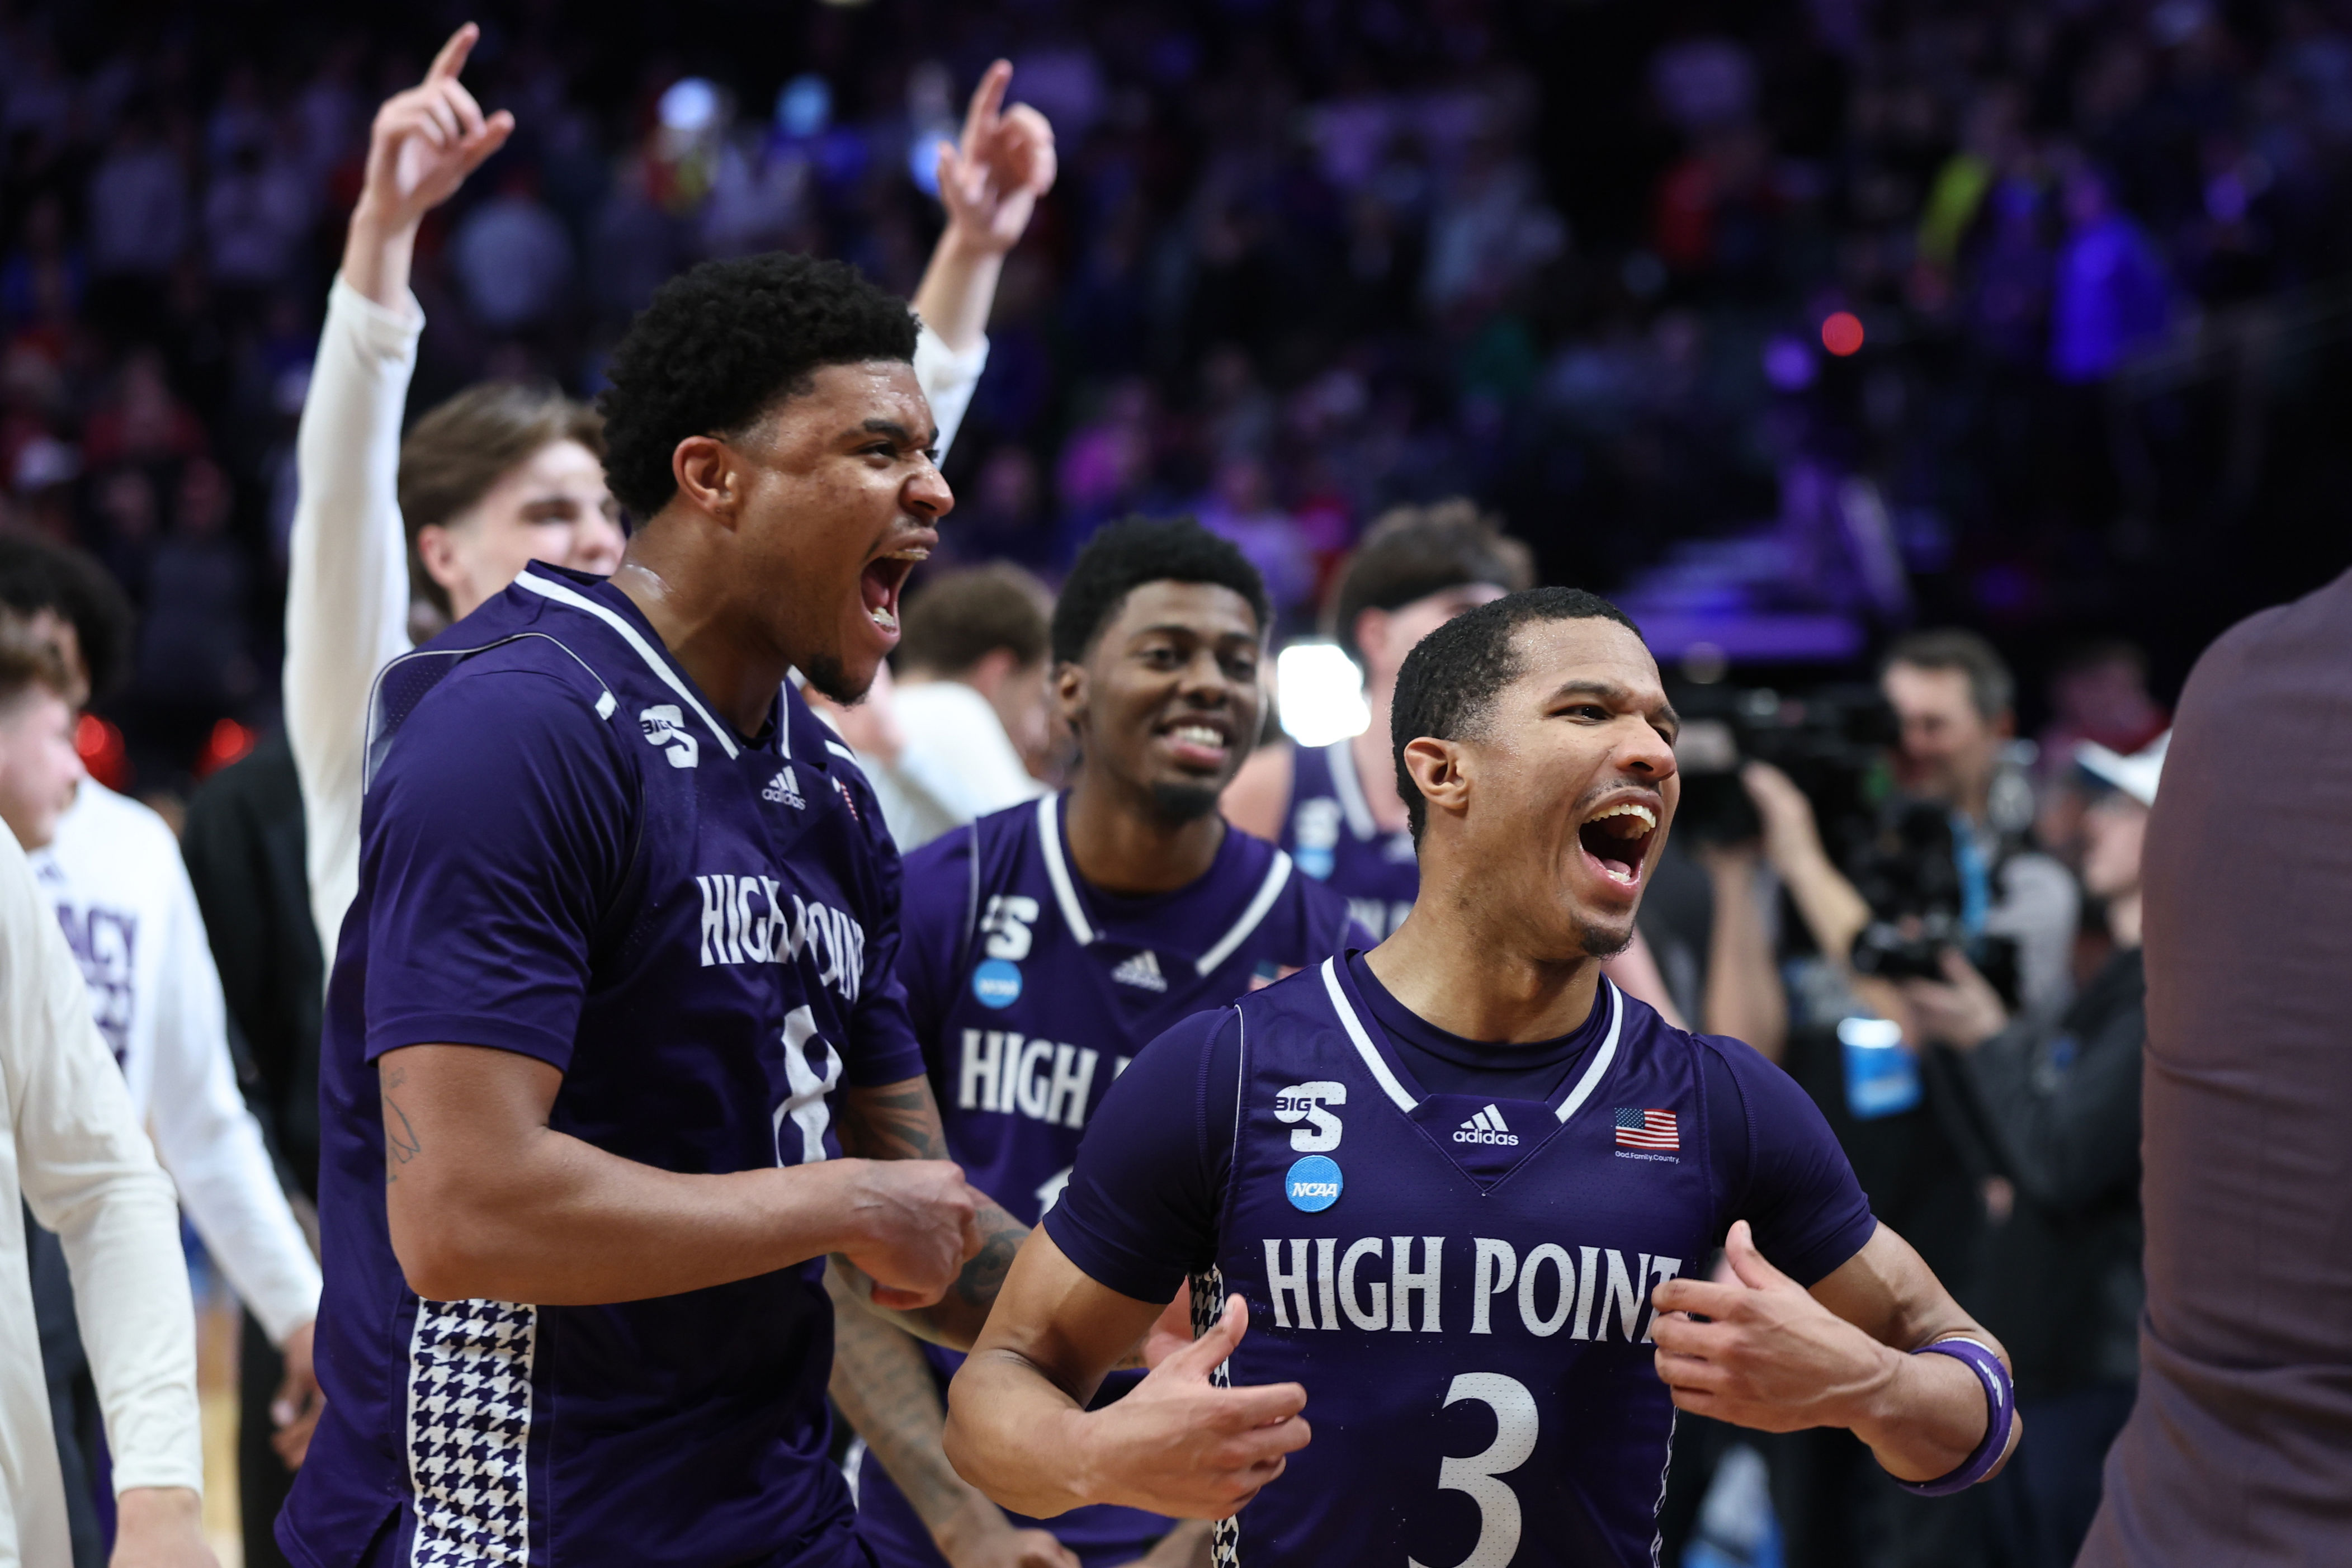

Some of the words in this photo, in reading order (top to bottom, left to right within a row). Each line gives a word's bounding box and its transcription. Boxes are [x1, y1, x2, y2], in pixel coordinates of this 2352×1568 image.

[762, 788, 806, 811] adidas
[696, 874, 791, 967] HIGH
[958, 1028, 1098, 1129] HIGH
[1275, 1097, 1312, 1111] BIG
[1453, 1128, 1519, 1146] adidas
[1292, 1182, 1338, 1197] NCAA
[1262, 1236, 1446, 1333] HIGH
[1470, 1237, 1682, 1343] POINT
[1408, 1372, 1539, 1568] 3
